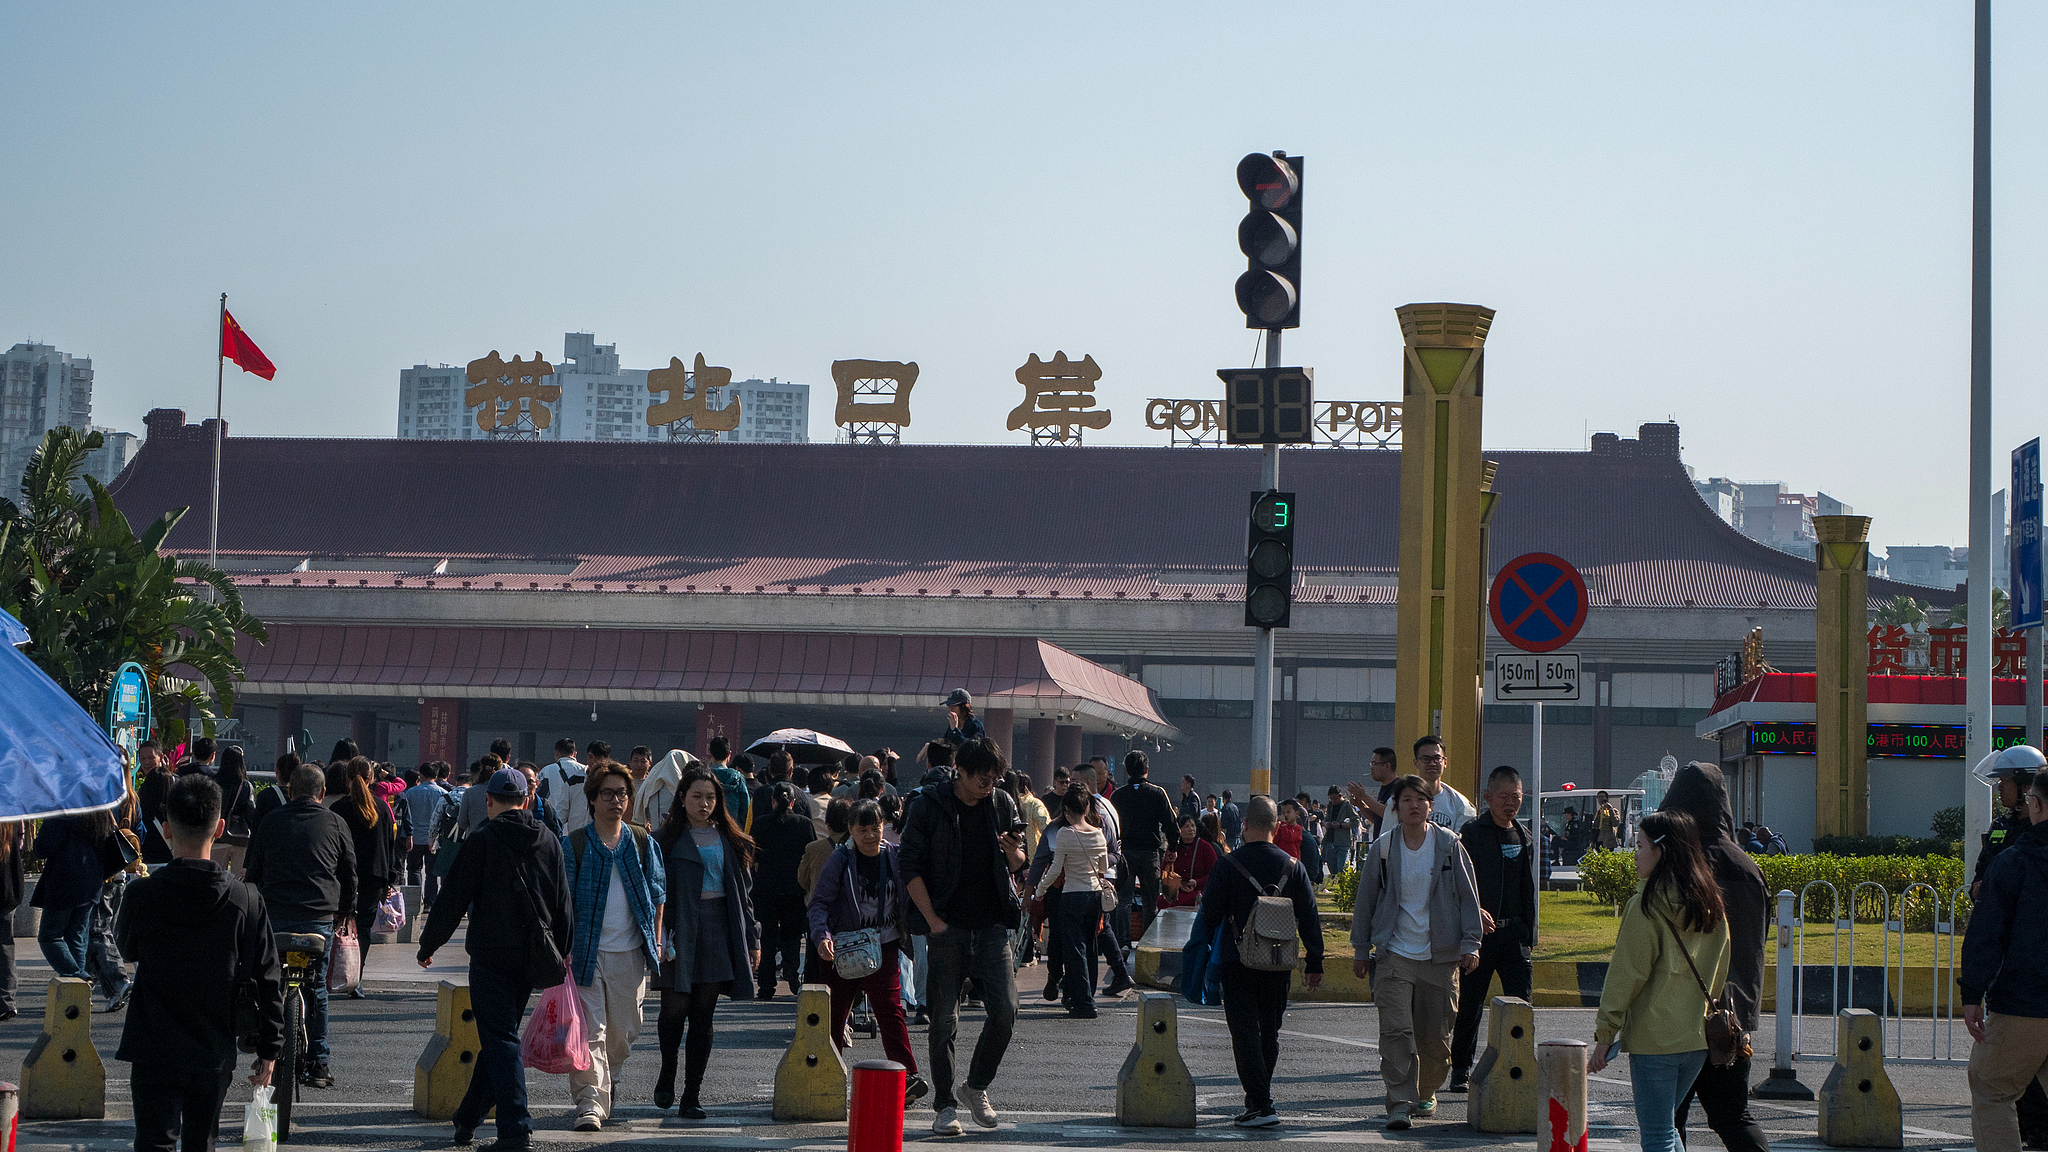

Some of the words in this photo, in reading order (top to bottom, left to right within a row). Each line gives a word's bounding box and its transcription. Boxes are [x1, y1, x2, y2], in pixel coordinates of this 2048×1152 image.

[465, 350, 1111, 441] 拱北口岸
[1275, 502, 1288, 527] 3
[1500, 663, 1535, 680] 150m
[1546, 662, 1575, 680] 50m
